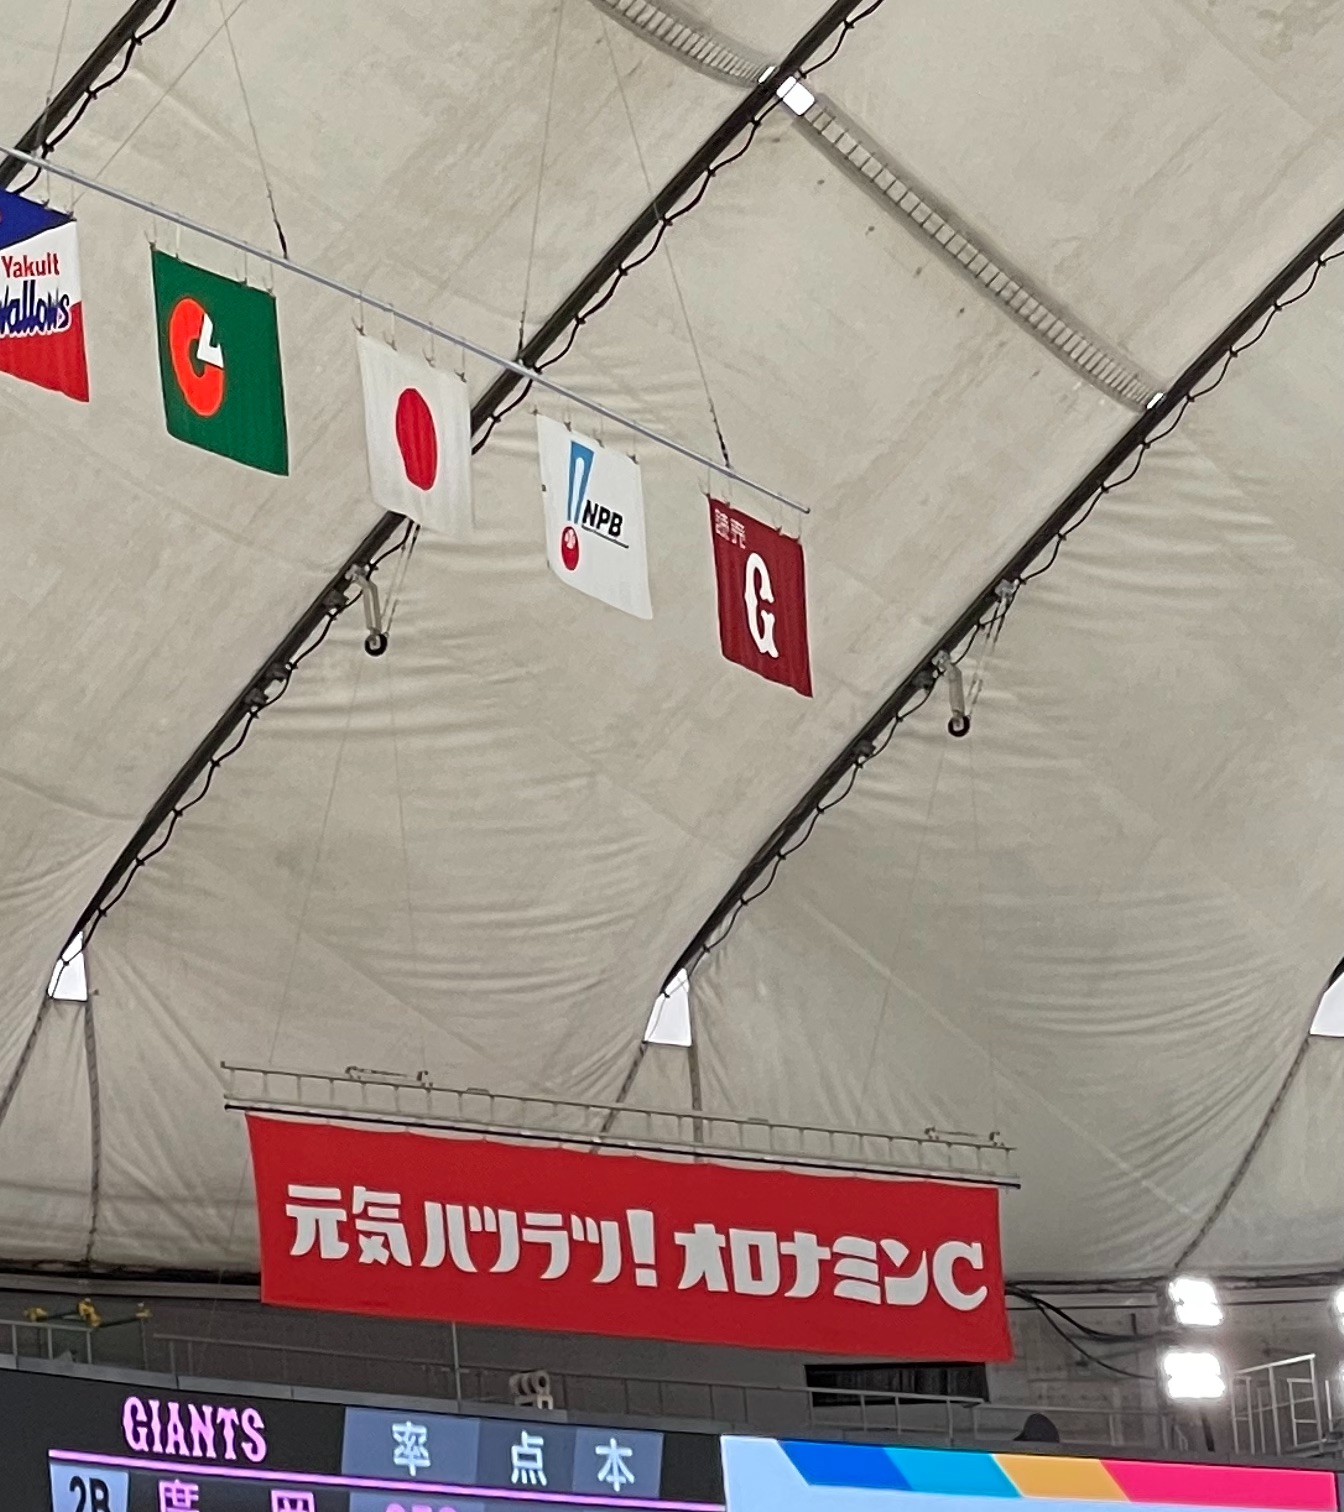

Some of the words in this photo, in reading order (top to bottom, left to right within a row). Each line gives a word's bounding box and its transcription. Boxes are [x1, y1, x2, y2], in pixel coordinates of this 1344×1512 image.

[0, 252, 60, 279] Yakult
[582, 499, 624, 537] NPB
[744, 552, 779, 658] G
[121, 1395, 269, 1464] GIANTS
[391, 1420, 433, 1478] 率
[509, 1430, 549, 1487] 点
[594, 1437, 636, 1494] 本
